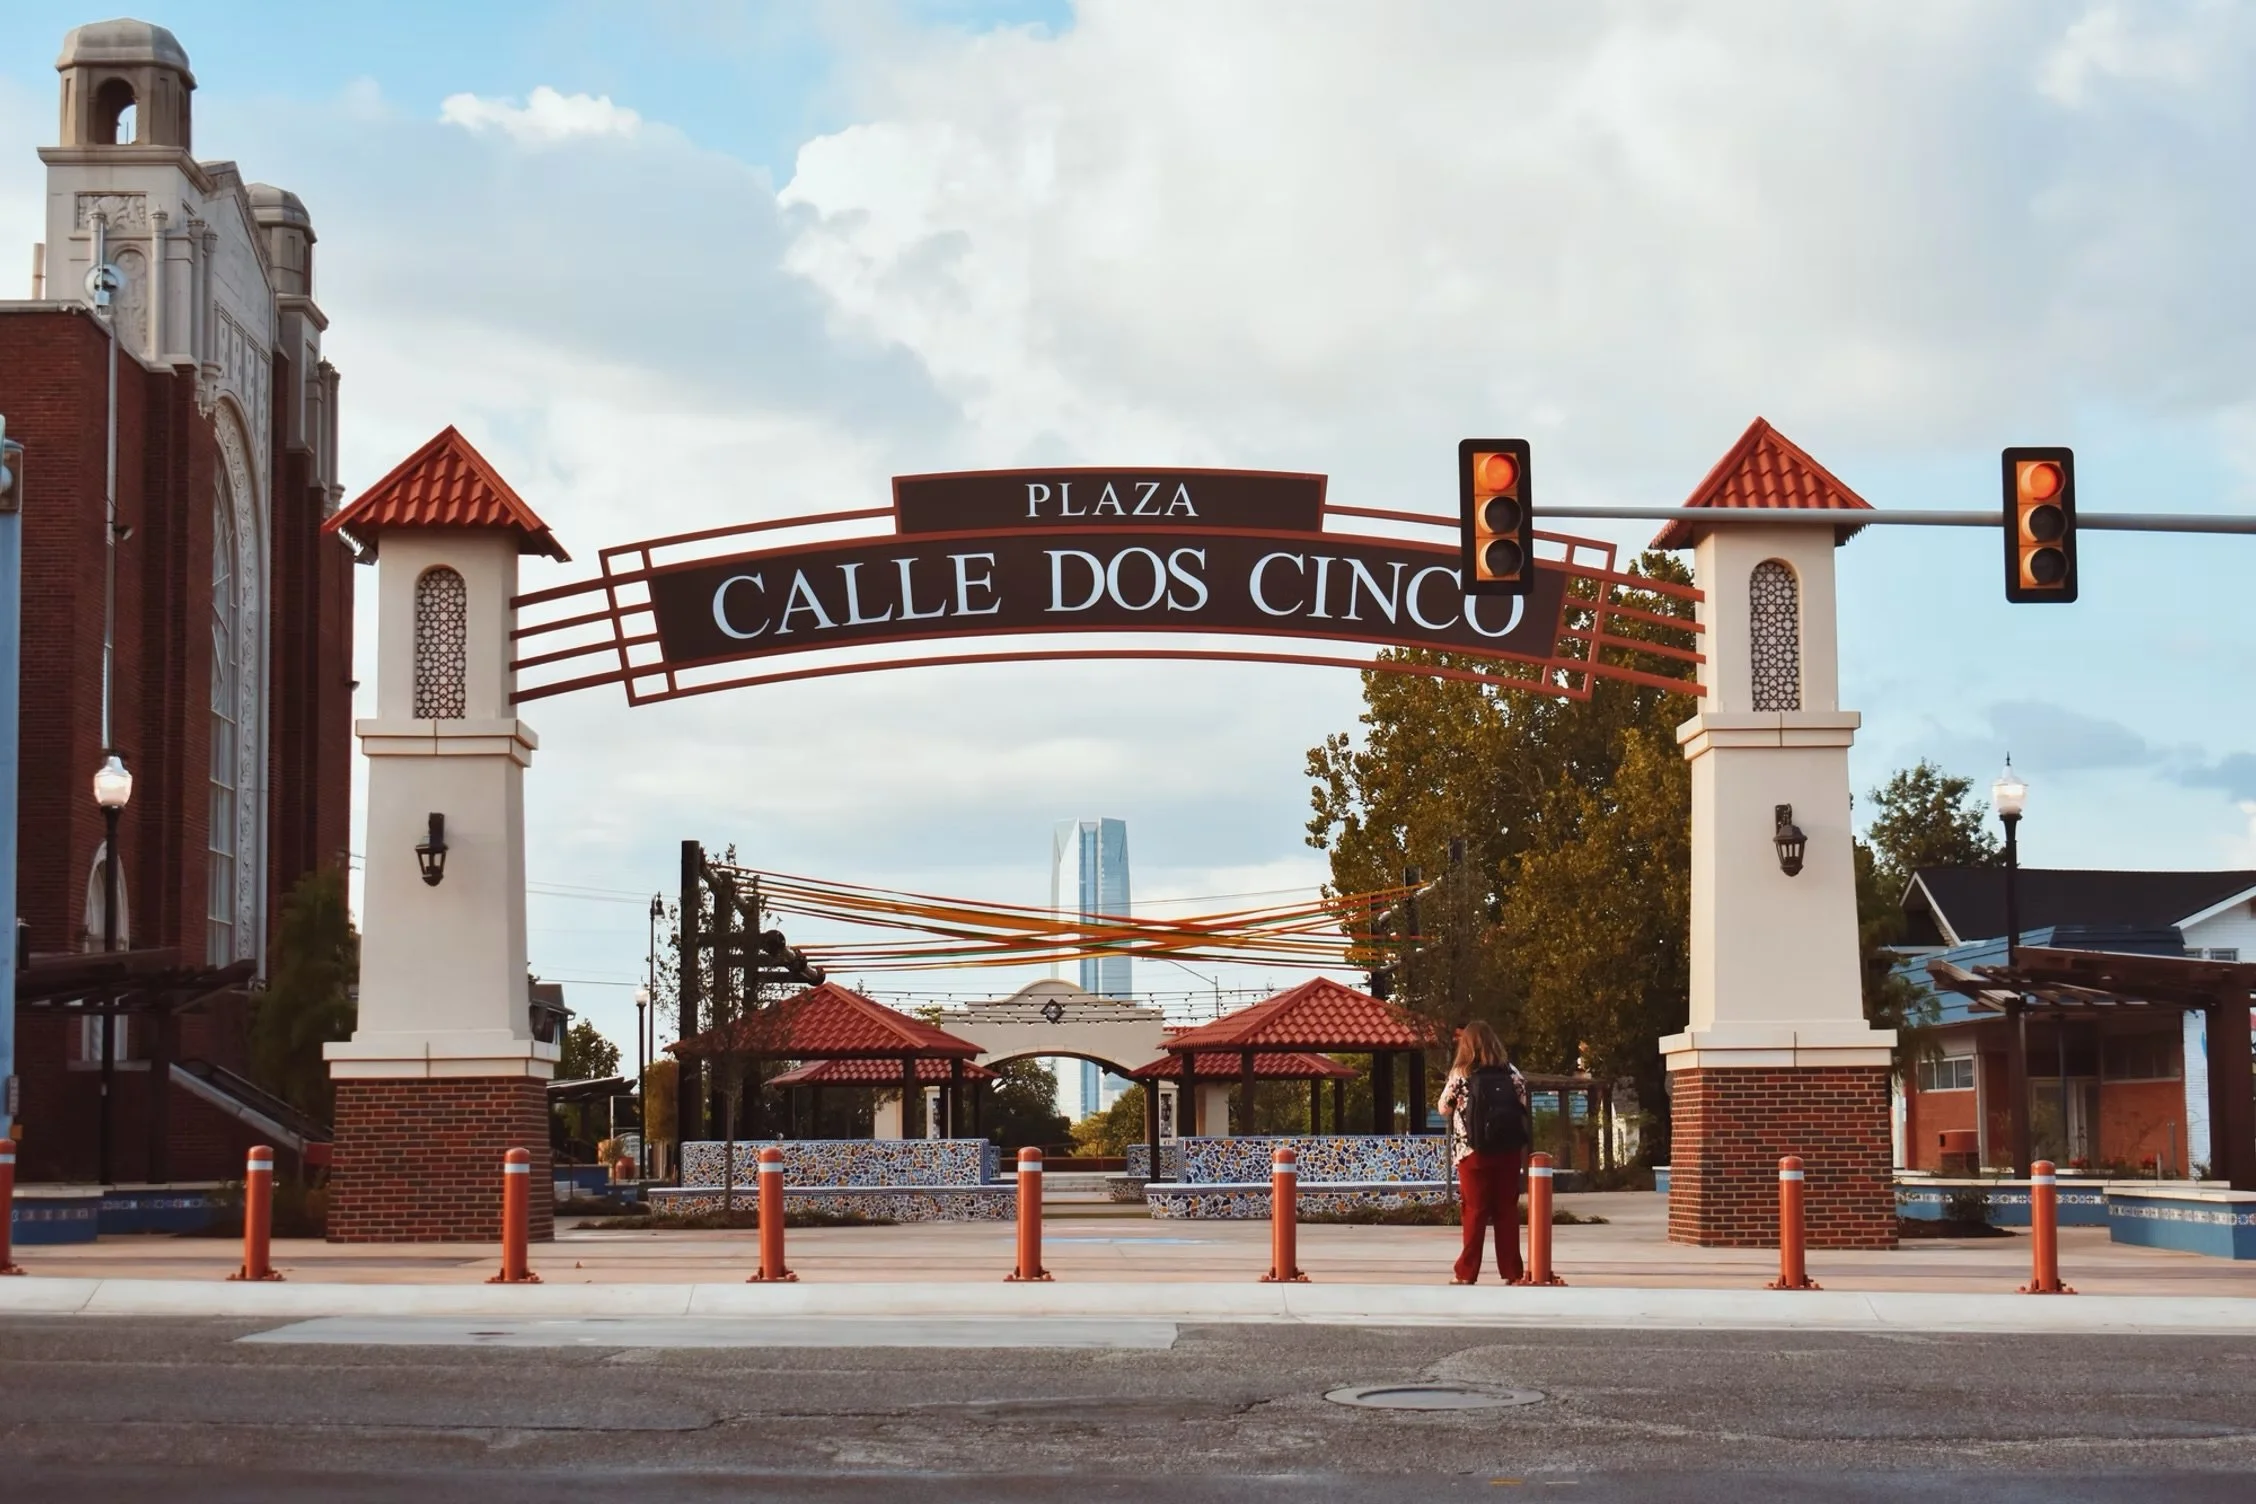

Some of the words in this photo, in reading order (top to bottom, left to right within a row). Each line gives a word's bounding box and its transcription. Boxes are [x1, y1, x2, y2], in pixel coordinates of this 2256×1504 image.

[1025, 481, 1200, 518] PLAZA
[712, 552, 1002, 639] CALLE
[1043, 546, 1210, 612] DOS
[1248, 551, 1526, 638] CINCO
